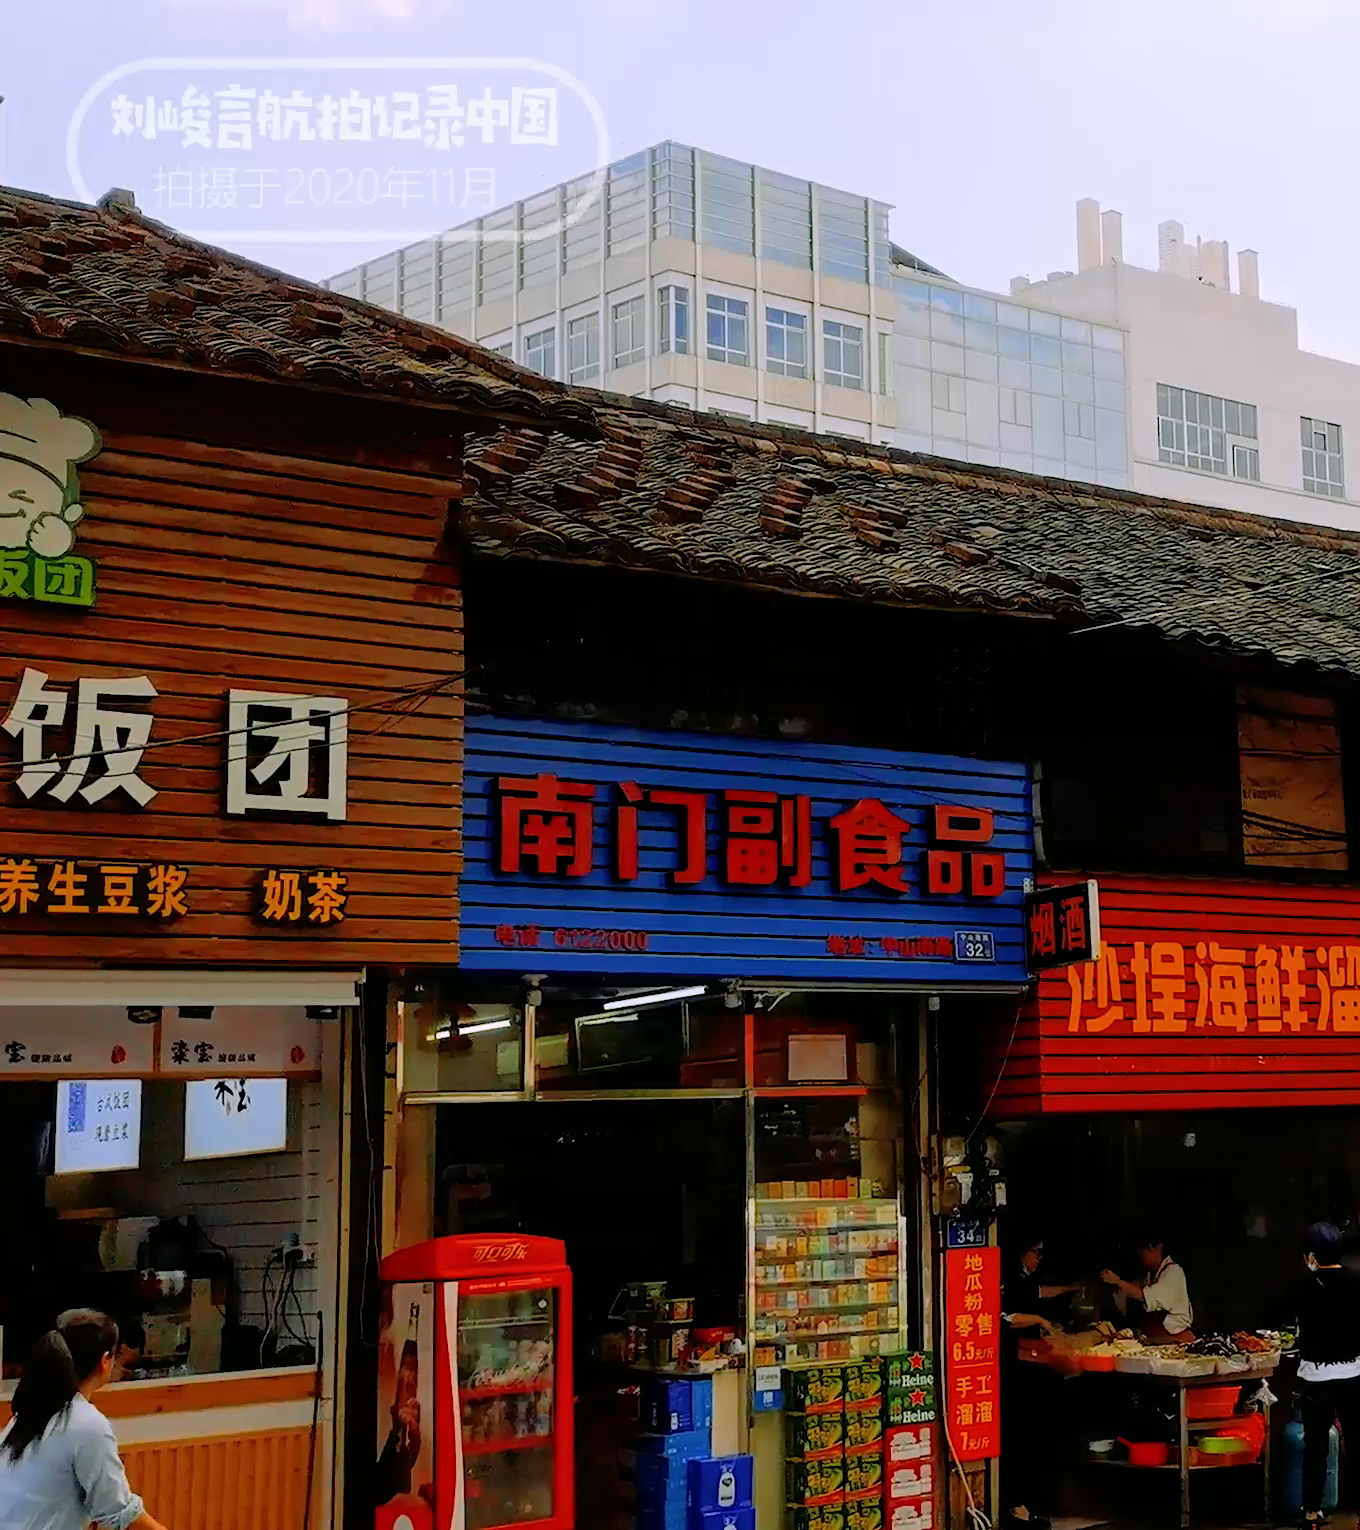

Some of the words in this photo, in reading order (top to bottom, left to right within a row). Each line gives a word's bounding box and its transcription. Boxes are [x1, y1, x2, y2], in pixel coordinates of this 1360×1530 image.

[1, 666, 349, 821] 饭团
[498, 773, 1005, 898] 南门副食品
[0, 858, 189, 918] 养生豆浆
[262, 867, 349, 925] 奶茶
[1029, 895, 1086, 957] 烟酒
[964, 1254, 984, 1312] 地瓜粉
[955, 1313, 993, 1338] 零售
[955, 1376, 992, 1399] 手工
